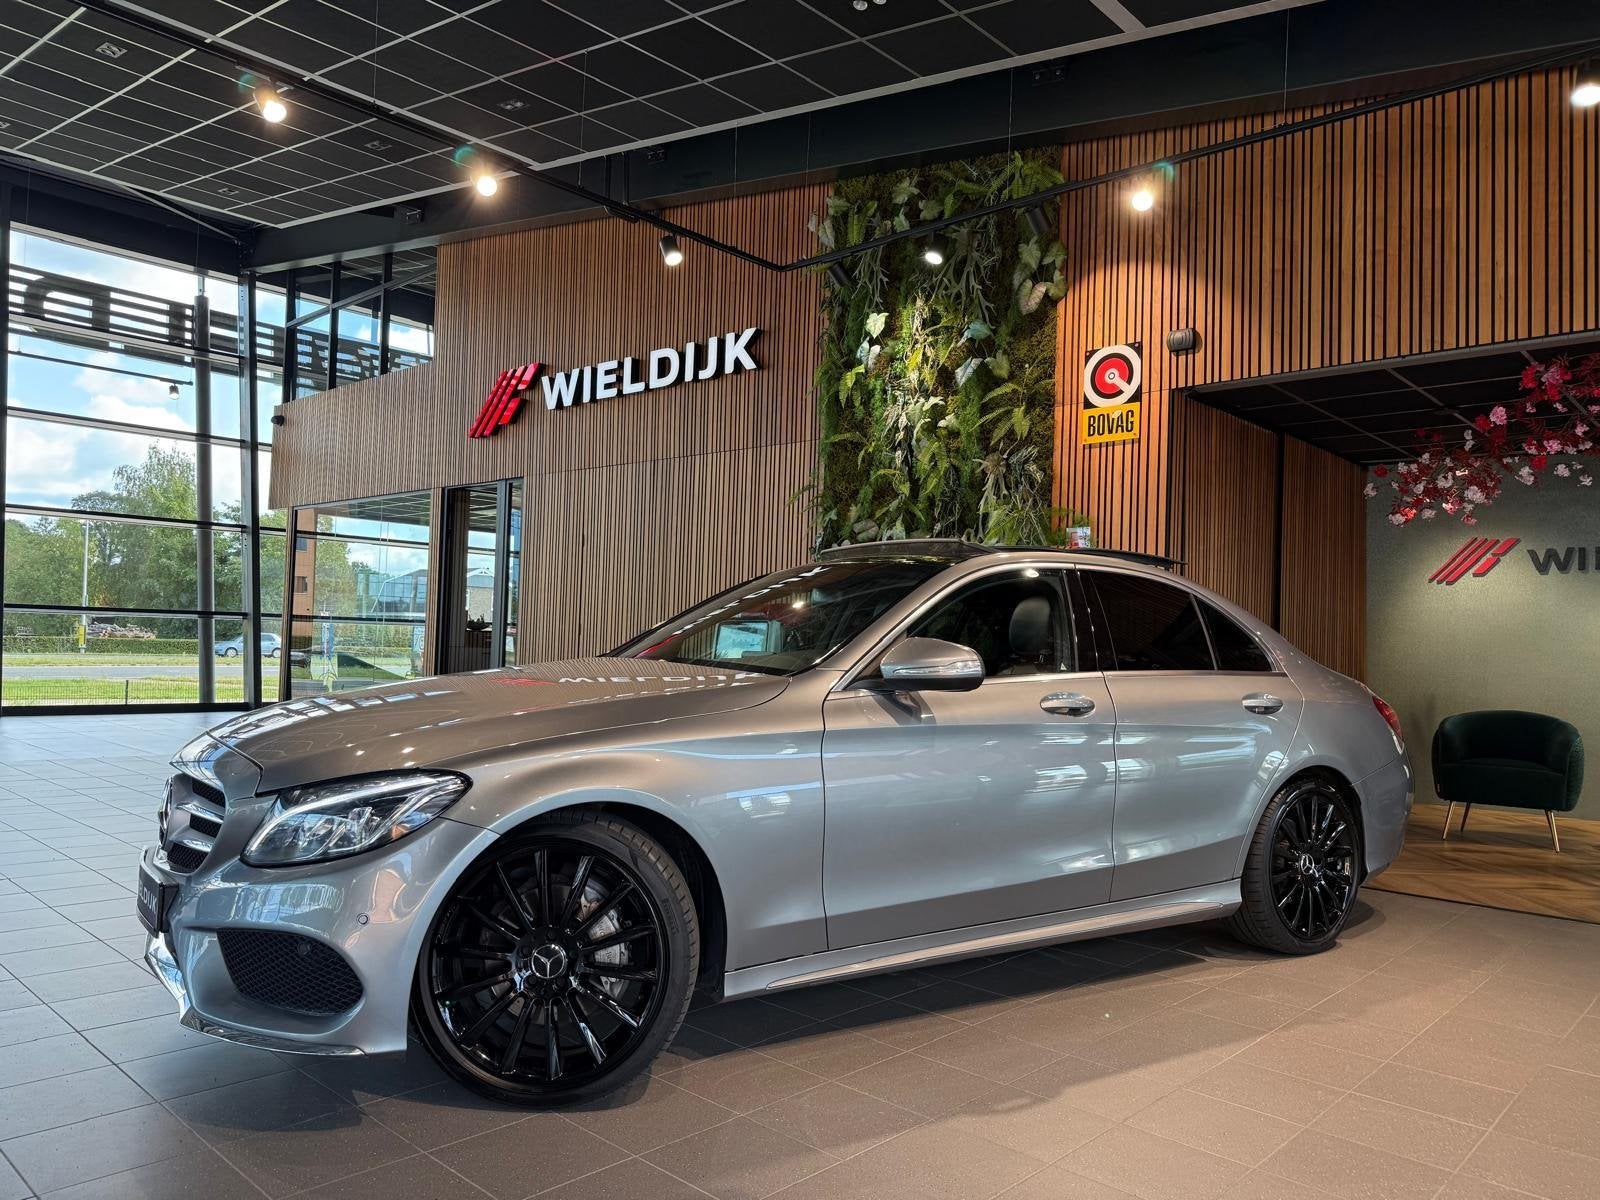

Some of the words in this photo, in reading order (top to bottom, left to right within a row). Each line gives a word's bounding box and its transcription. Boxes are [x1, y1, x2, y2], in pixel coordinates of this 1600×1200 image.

[541, 327, 760, 411] WIELDIJK
[1087, 409, 1135, 437] BOVAG
[1526, 546, 1600, 575] WI
